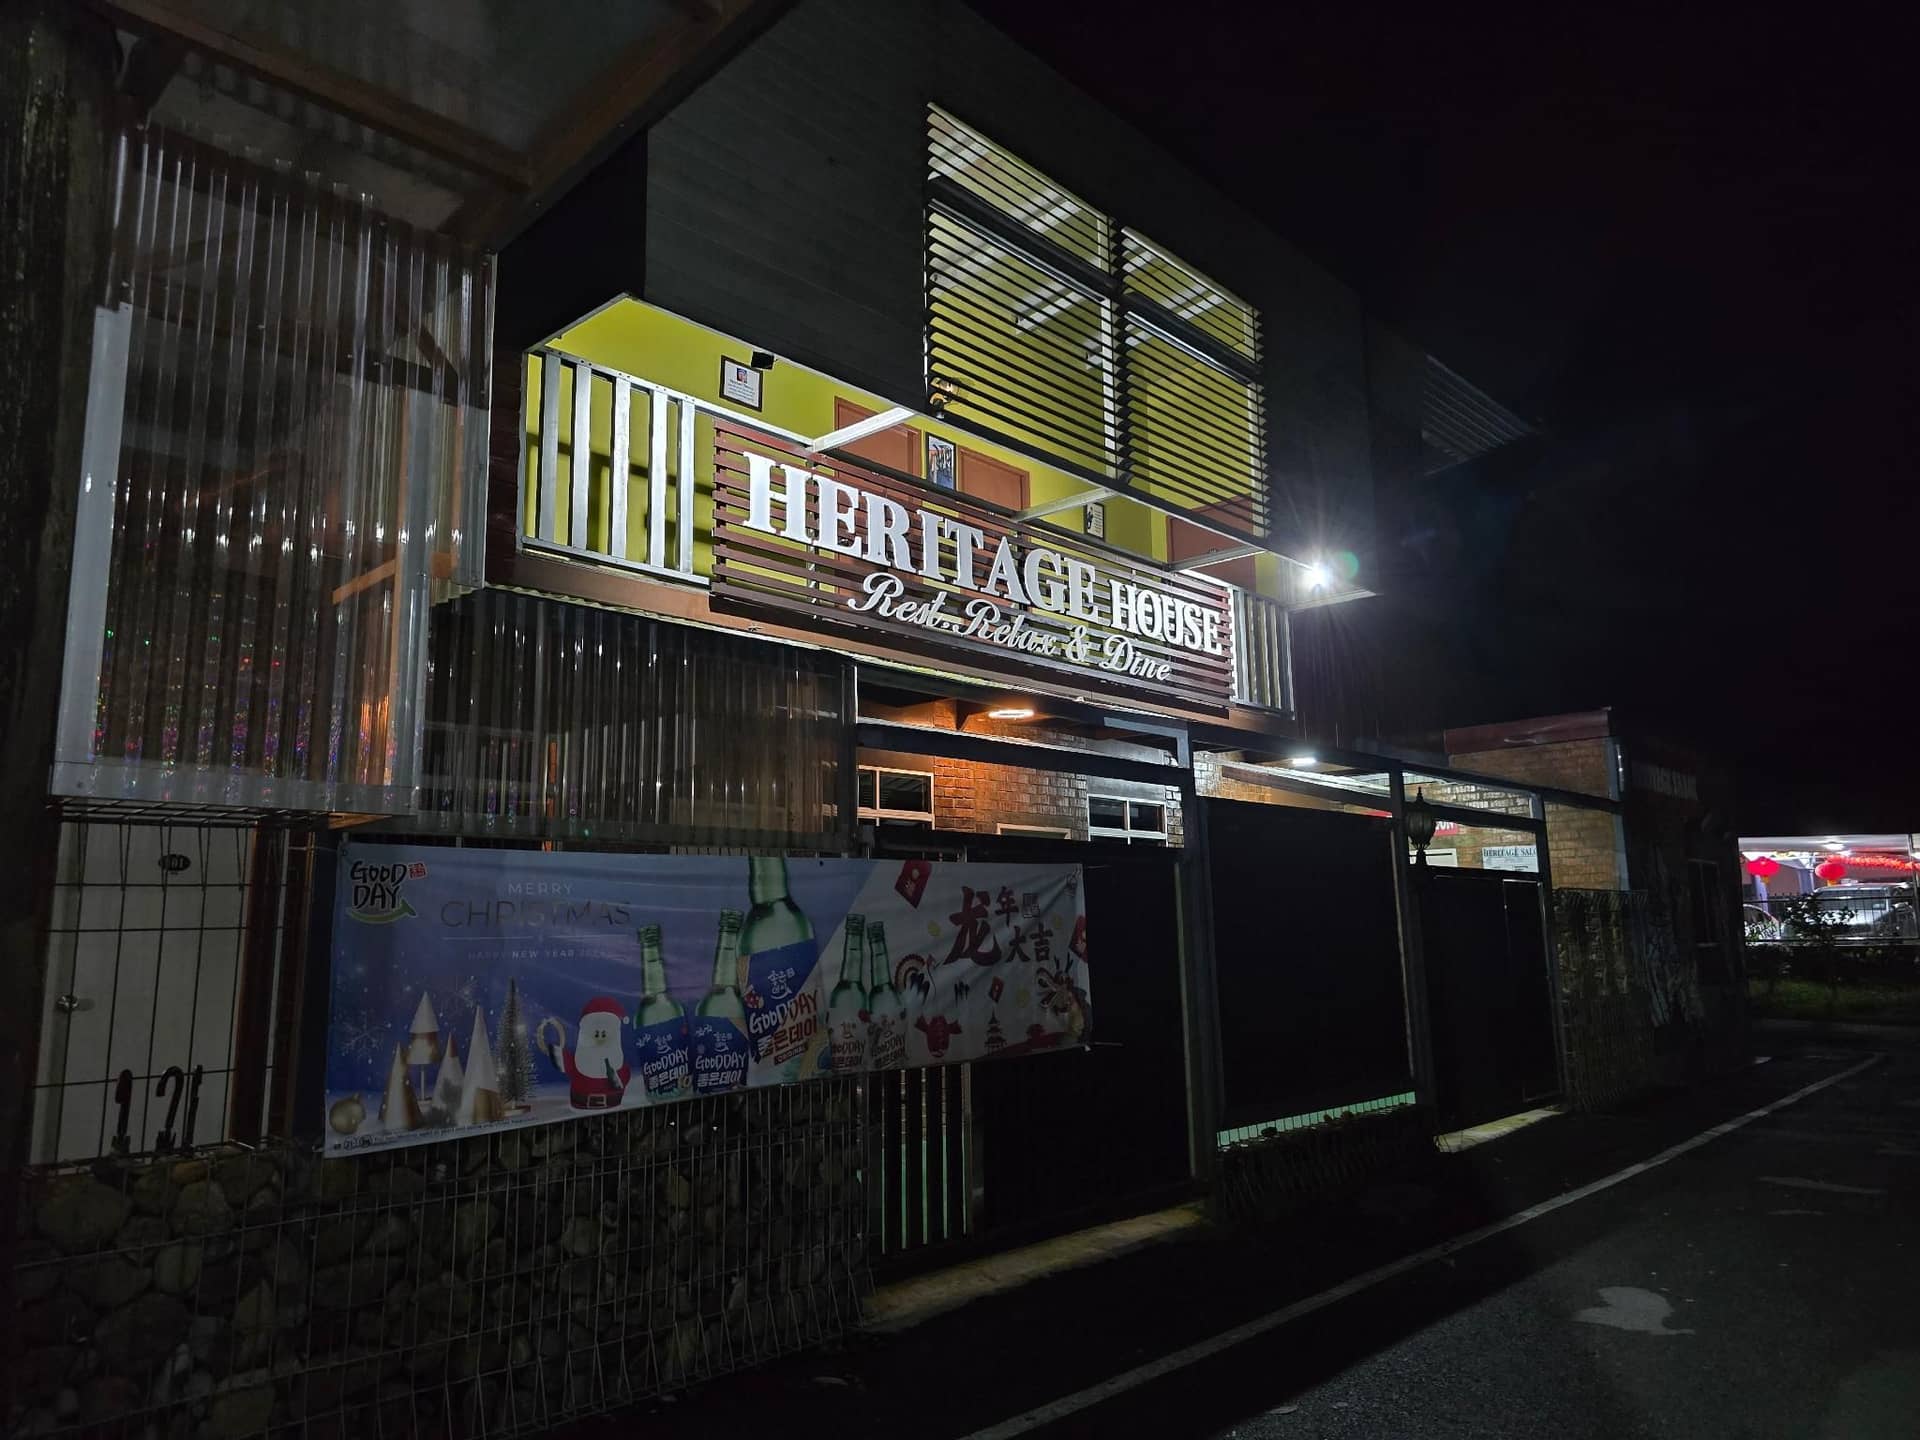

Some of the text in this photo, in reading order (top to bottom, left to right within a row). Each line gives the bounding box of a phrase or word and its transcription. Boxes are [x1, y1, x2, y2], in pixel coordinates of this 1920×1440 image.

[741, 450, 1224, 657] HERITAGE HOUSE
[953, 598, 1058, 658] Relax
[1065, 624, 1092, 665] &
[1097, 634, 1173, 683] Dine
[350, 860, 407, 887] GOOD
[353, 883, 400, 910] DAY
[507, 881, 574, 897] MERRY
[440, 898, 632, 928] CHRISTMAS
[511, 950, 537, 961] NEW
